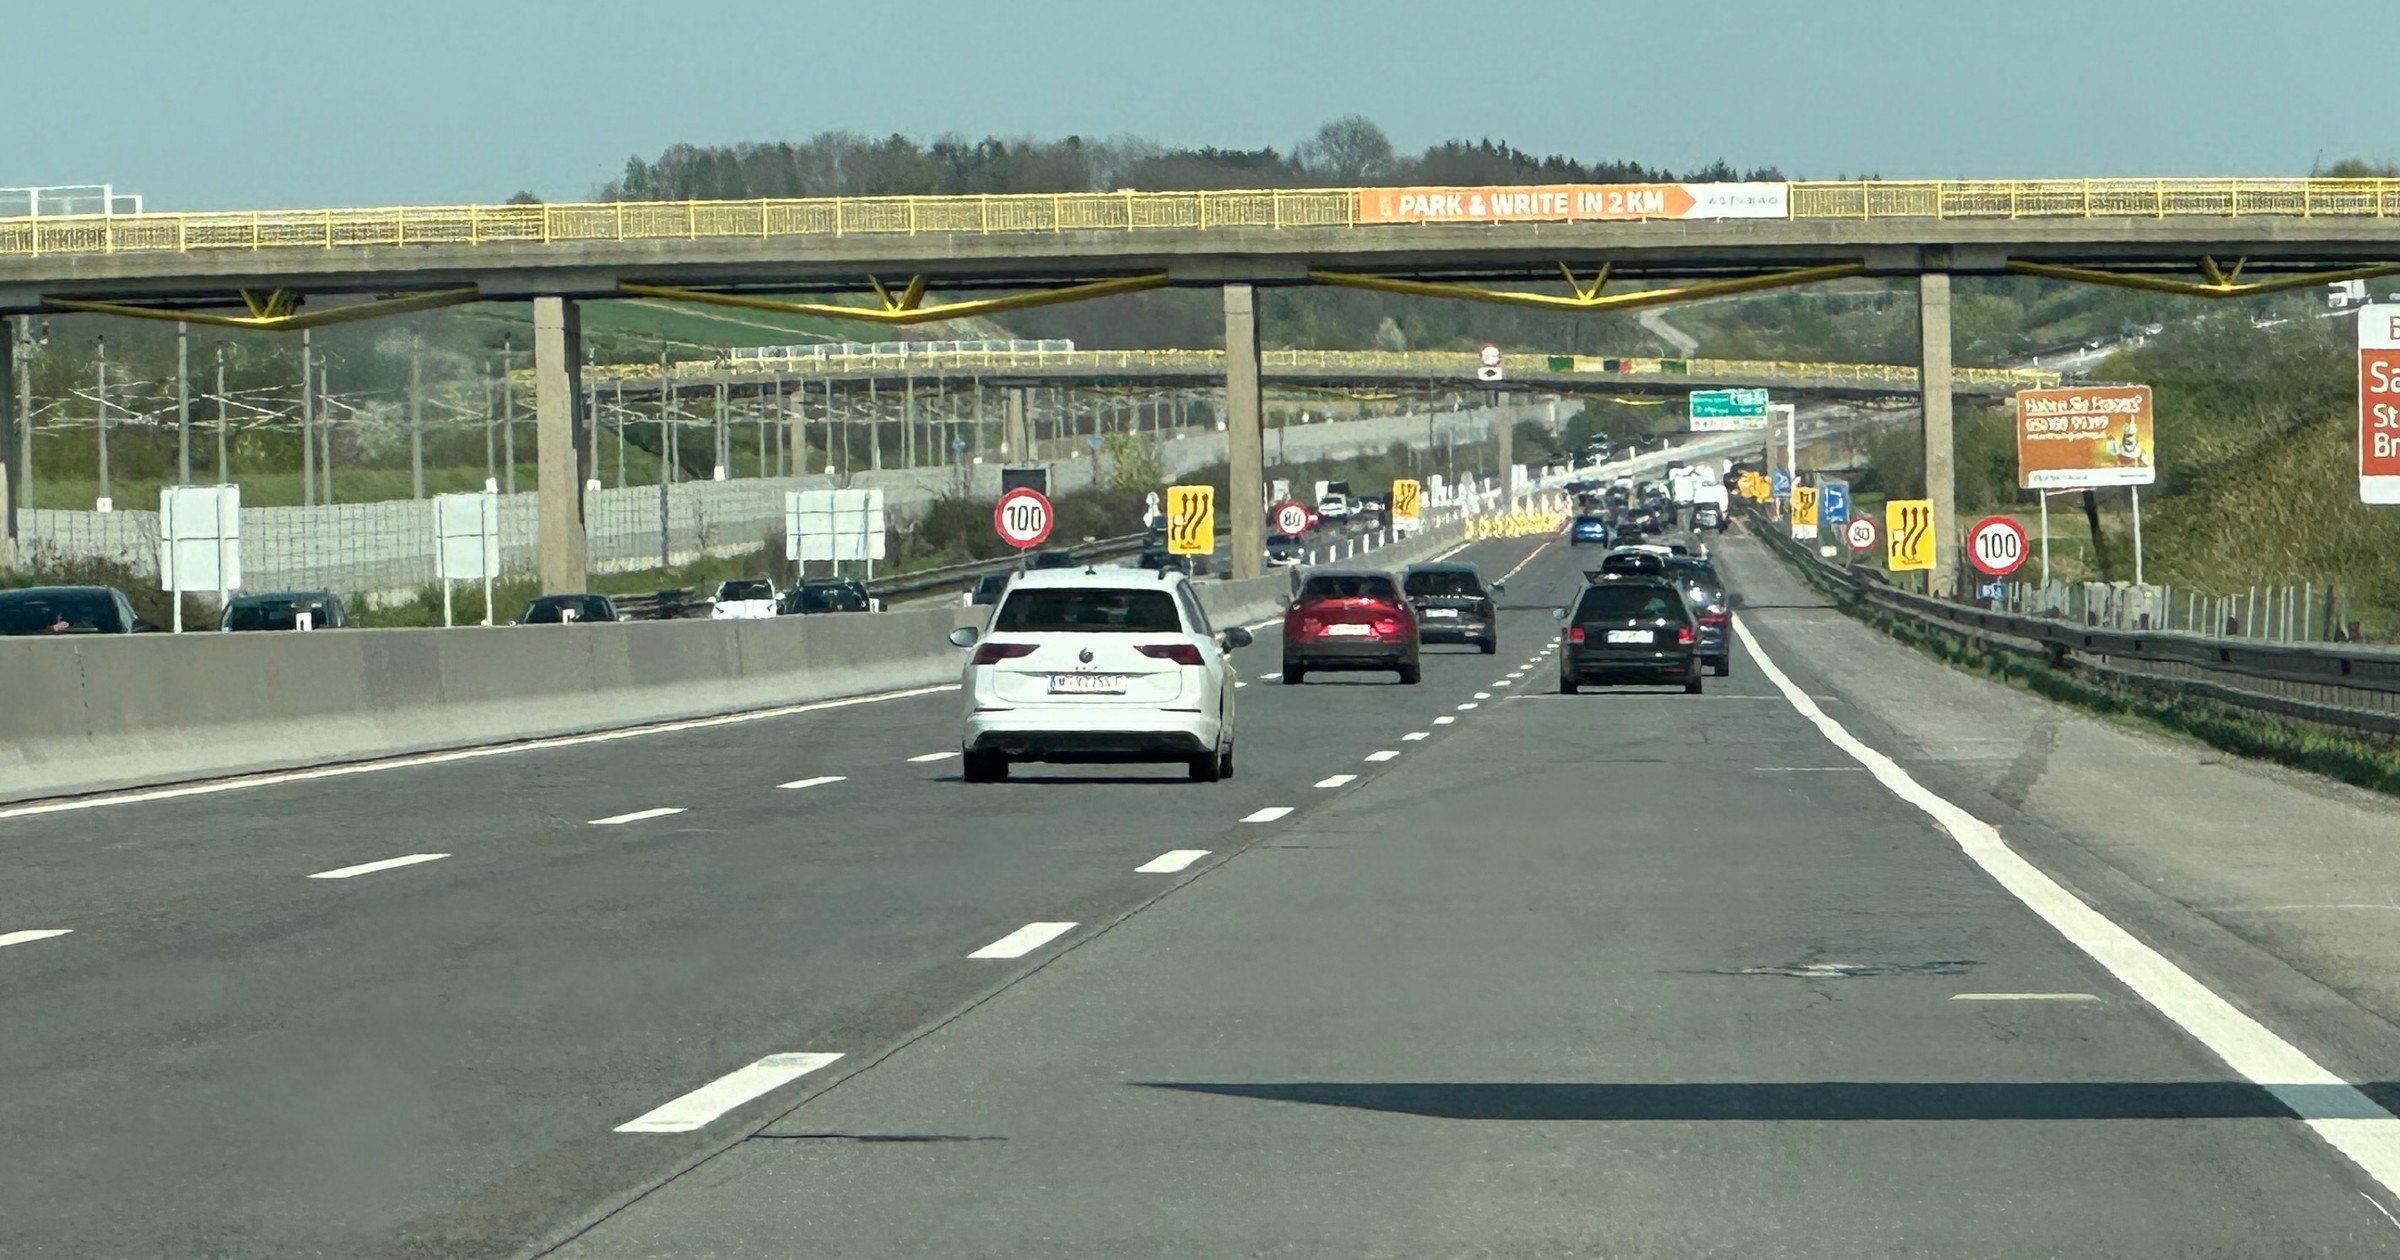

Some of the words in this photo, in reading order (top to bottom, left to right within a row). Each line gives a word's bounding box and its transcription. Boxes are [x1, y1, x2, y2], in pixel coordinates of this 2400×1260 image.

[1400, 191, 1464, 217] PARK
[1468, 194, 1487, 217] &
[1490, 192, 1569, 216] WRITE
[1576, 191, 1603, 214] IN
[1608, 191, 1624, 214] 2
[1626, 190, 1665, 214] KM
[2370, 360, 2400, 393] Sa
[1007, 505, 1041, 531] 100
[1980, 532, 2017, 558] 100
